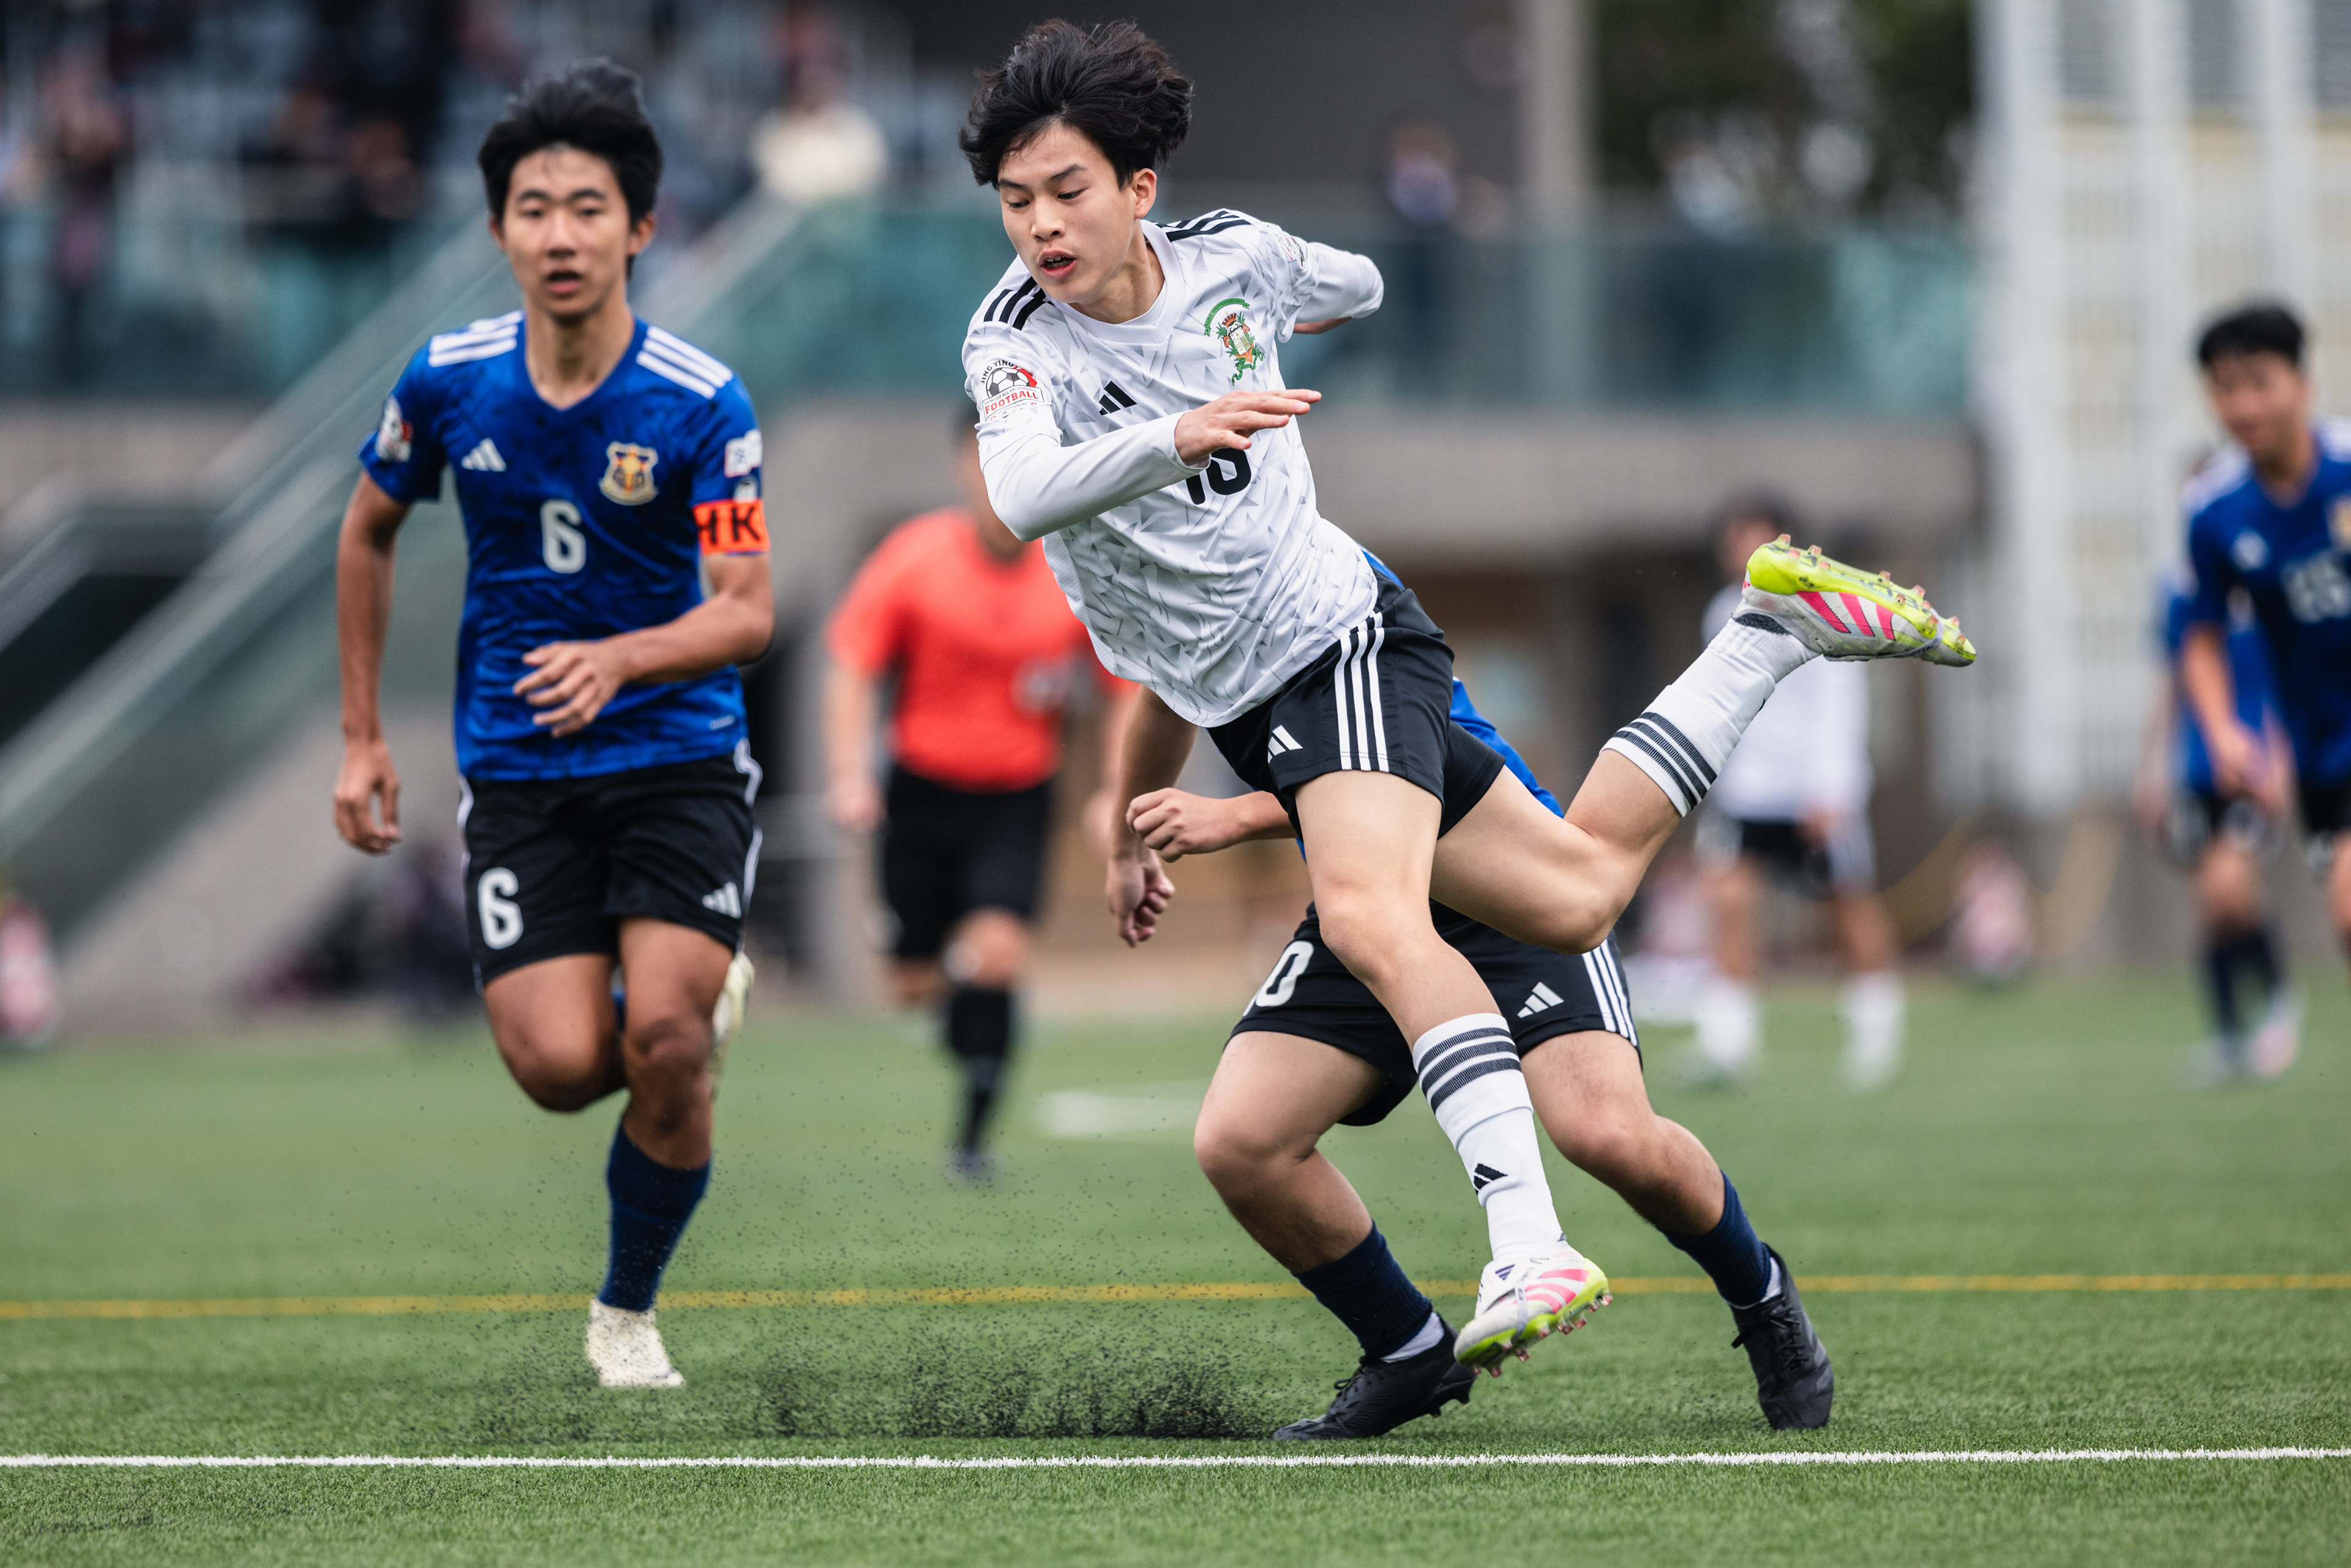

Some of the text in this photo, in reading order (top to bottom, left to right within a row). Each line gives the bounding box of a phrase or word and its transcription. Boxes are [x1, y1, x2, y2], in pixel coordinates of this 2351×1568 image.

[981, 366, 992, 384] JING
[984, 391, 1039, 415] FOOTBALL
[539, 500, 587, 574] 6
[478, 866, 524, 950] 6
[1242, 940, 1314, 1016] 0
